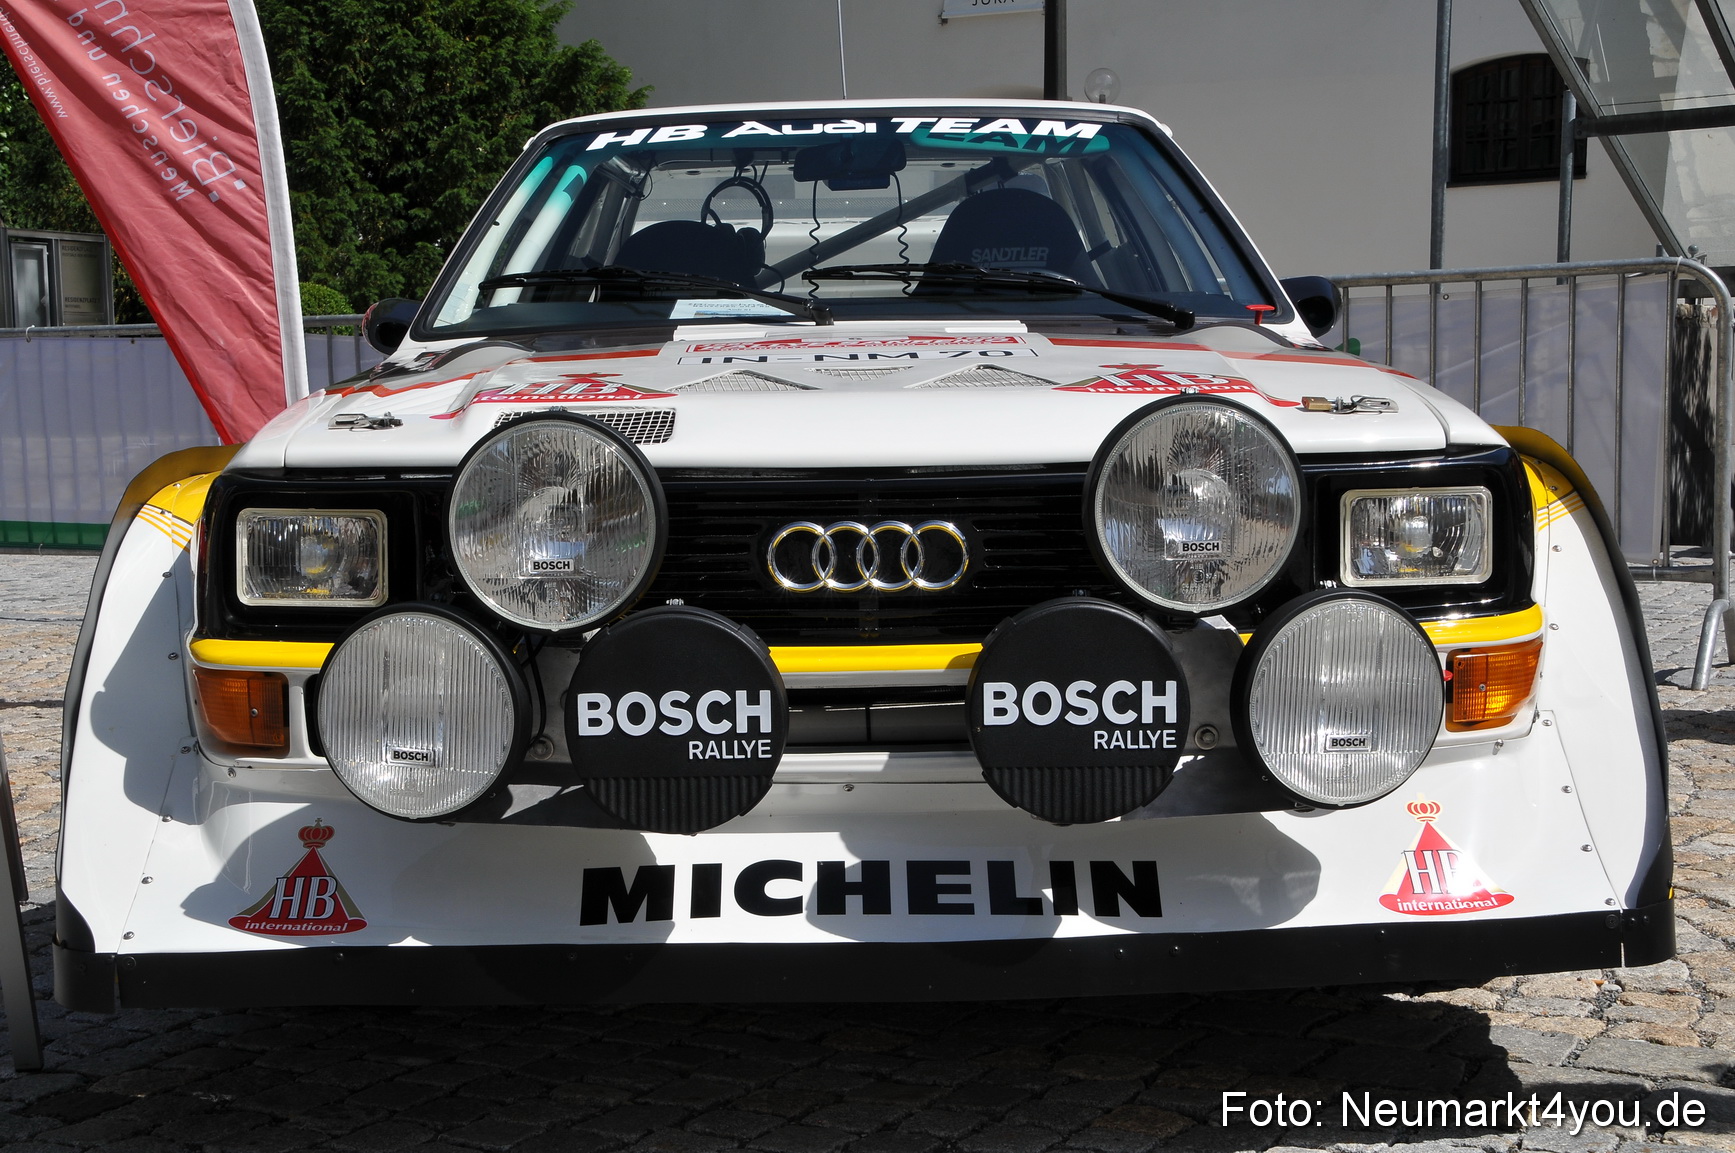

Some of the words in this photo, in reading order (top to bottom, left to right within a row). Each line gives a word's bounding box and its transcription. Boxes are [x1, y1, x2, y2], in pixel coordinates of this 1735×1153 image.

[586, 124, 706, 151] HB
[721, 120, 876, 139] Audi
[890, 117, 1102, 139] TEAM
[971, 247, 1049, 263] SANDTLER
[1102, 373, 1230, 386] HB
[498, 382, 623, 394] HB
[1182, 542, 1220, 553] BOSCH
[532, 560, 571, 571] BOSCH
[983, 680, 1177, 726] BOSCH
[577, 689, 772, 737] BOSCH
[1093, 729, 1177, 750] RALLYE
[1331, 737, 1366, 748] BOSCH
[393, 750, 429, 762] BOSCH
[688, 739, 772, 760] RALLYE
[268, 875, 338, 919] HB
[579, 859, 1164, 927] MICHELIN
[1396, 897, 1499, 912] international
[244, 920, 348, 932] international
